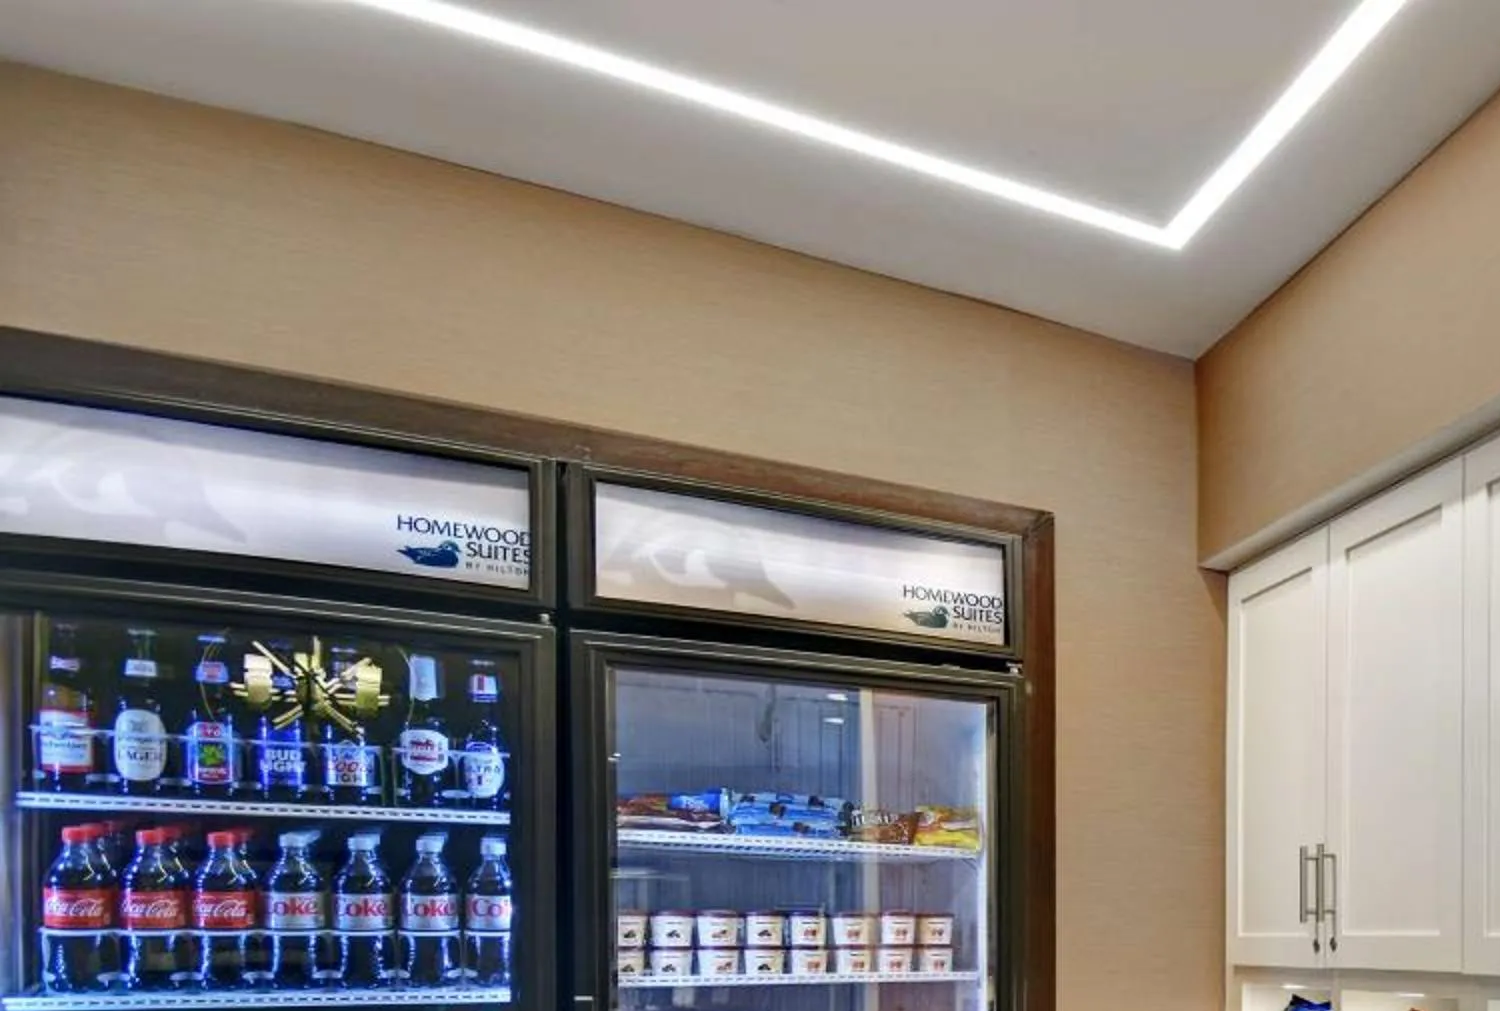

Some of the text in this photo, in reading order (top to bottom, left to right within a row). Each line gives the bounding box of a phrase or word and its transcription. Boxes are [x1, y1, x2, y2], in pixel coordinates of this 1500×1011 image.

[397, 514, 531, 547] HOMEWOOD
[466, 541, 531, 564] SUITES
[902, 584, 1003, 610] HOMEWOOD
[953, 605, 1003, 625] SUITES
